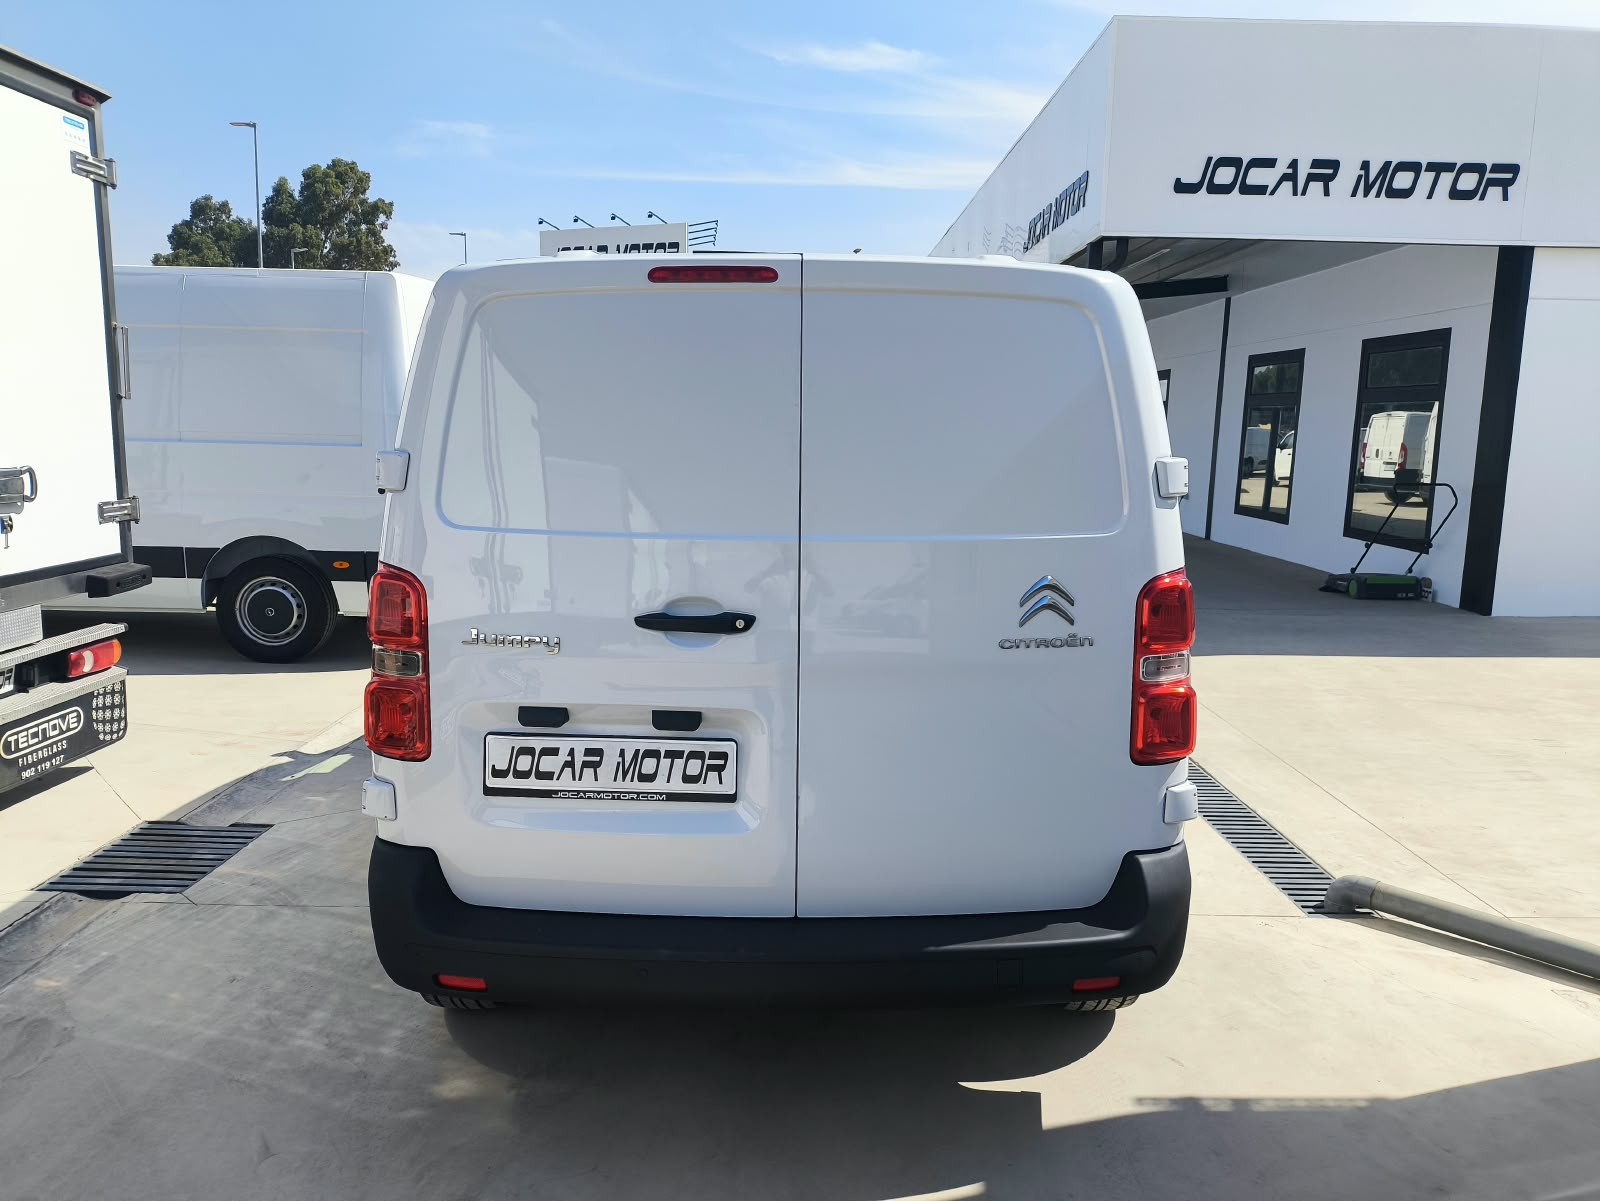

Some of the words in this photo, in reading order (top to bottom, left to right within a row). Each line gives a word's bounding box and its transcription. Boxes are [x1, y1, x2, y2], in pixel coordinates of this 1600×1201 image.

[1174, 156, 1340, 197] JOCAR
[1351, 160, 1521, 202] MOTOR
[1052, 170, 1089, 231] MOTOR
[462, 628, 561, 655] Jumpy
[8, 712, 78, 752] TECNOVE
[18, 740, 67, 767] FIBERGLASS
[21, 767, 36, 780] 902
[37, 761, 51, 773] 119
[52, 755, 65, 766] 127
[491, 745, 604, 782] JOCAR
[613, 748, 729, 785] MOTOR
[552, 792, 667, 801] JOCARMOTOR.COM
